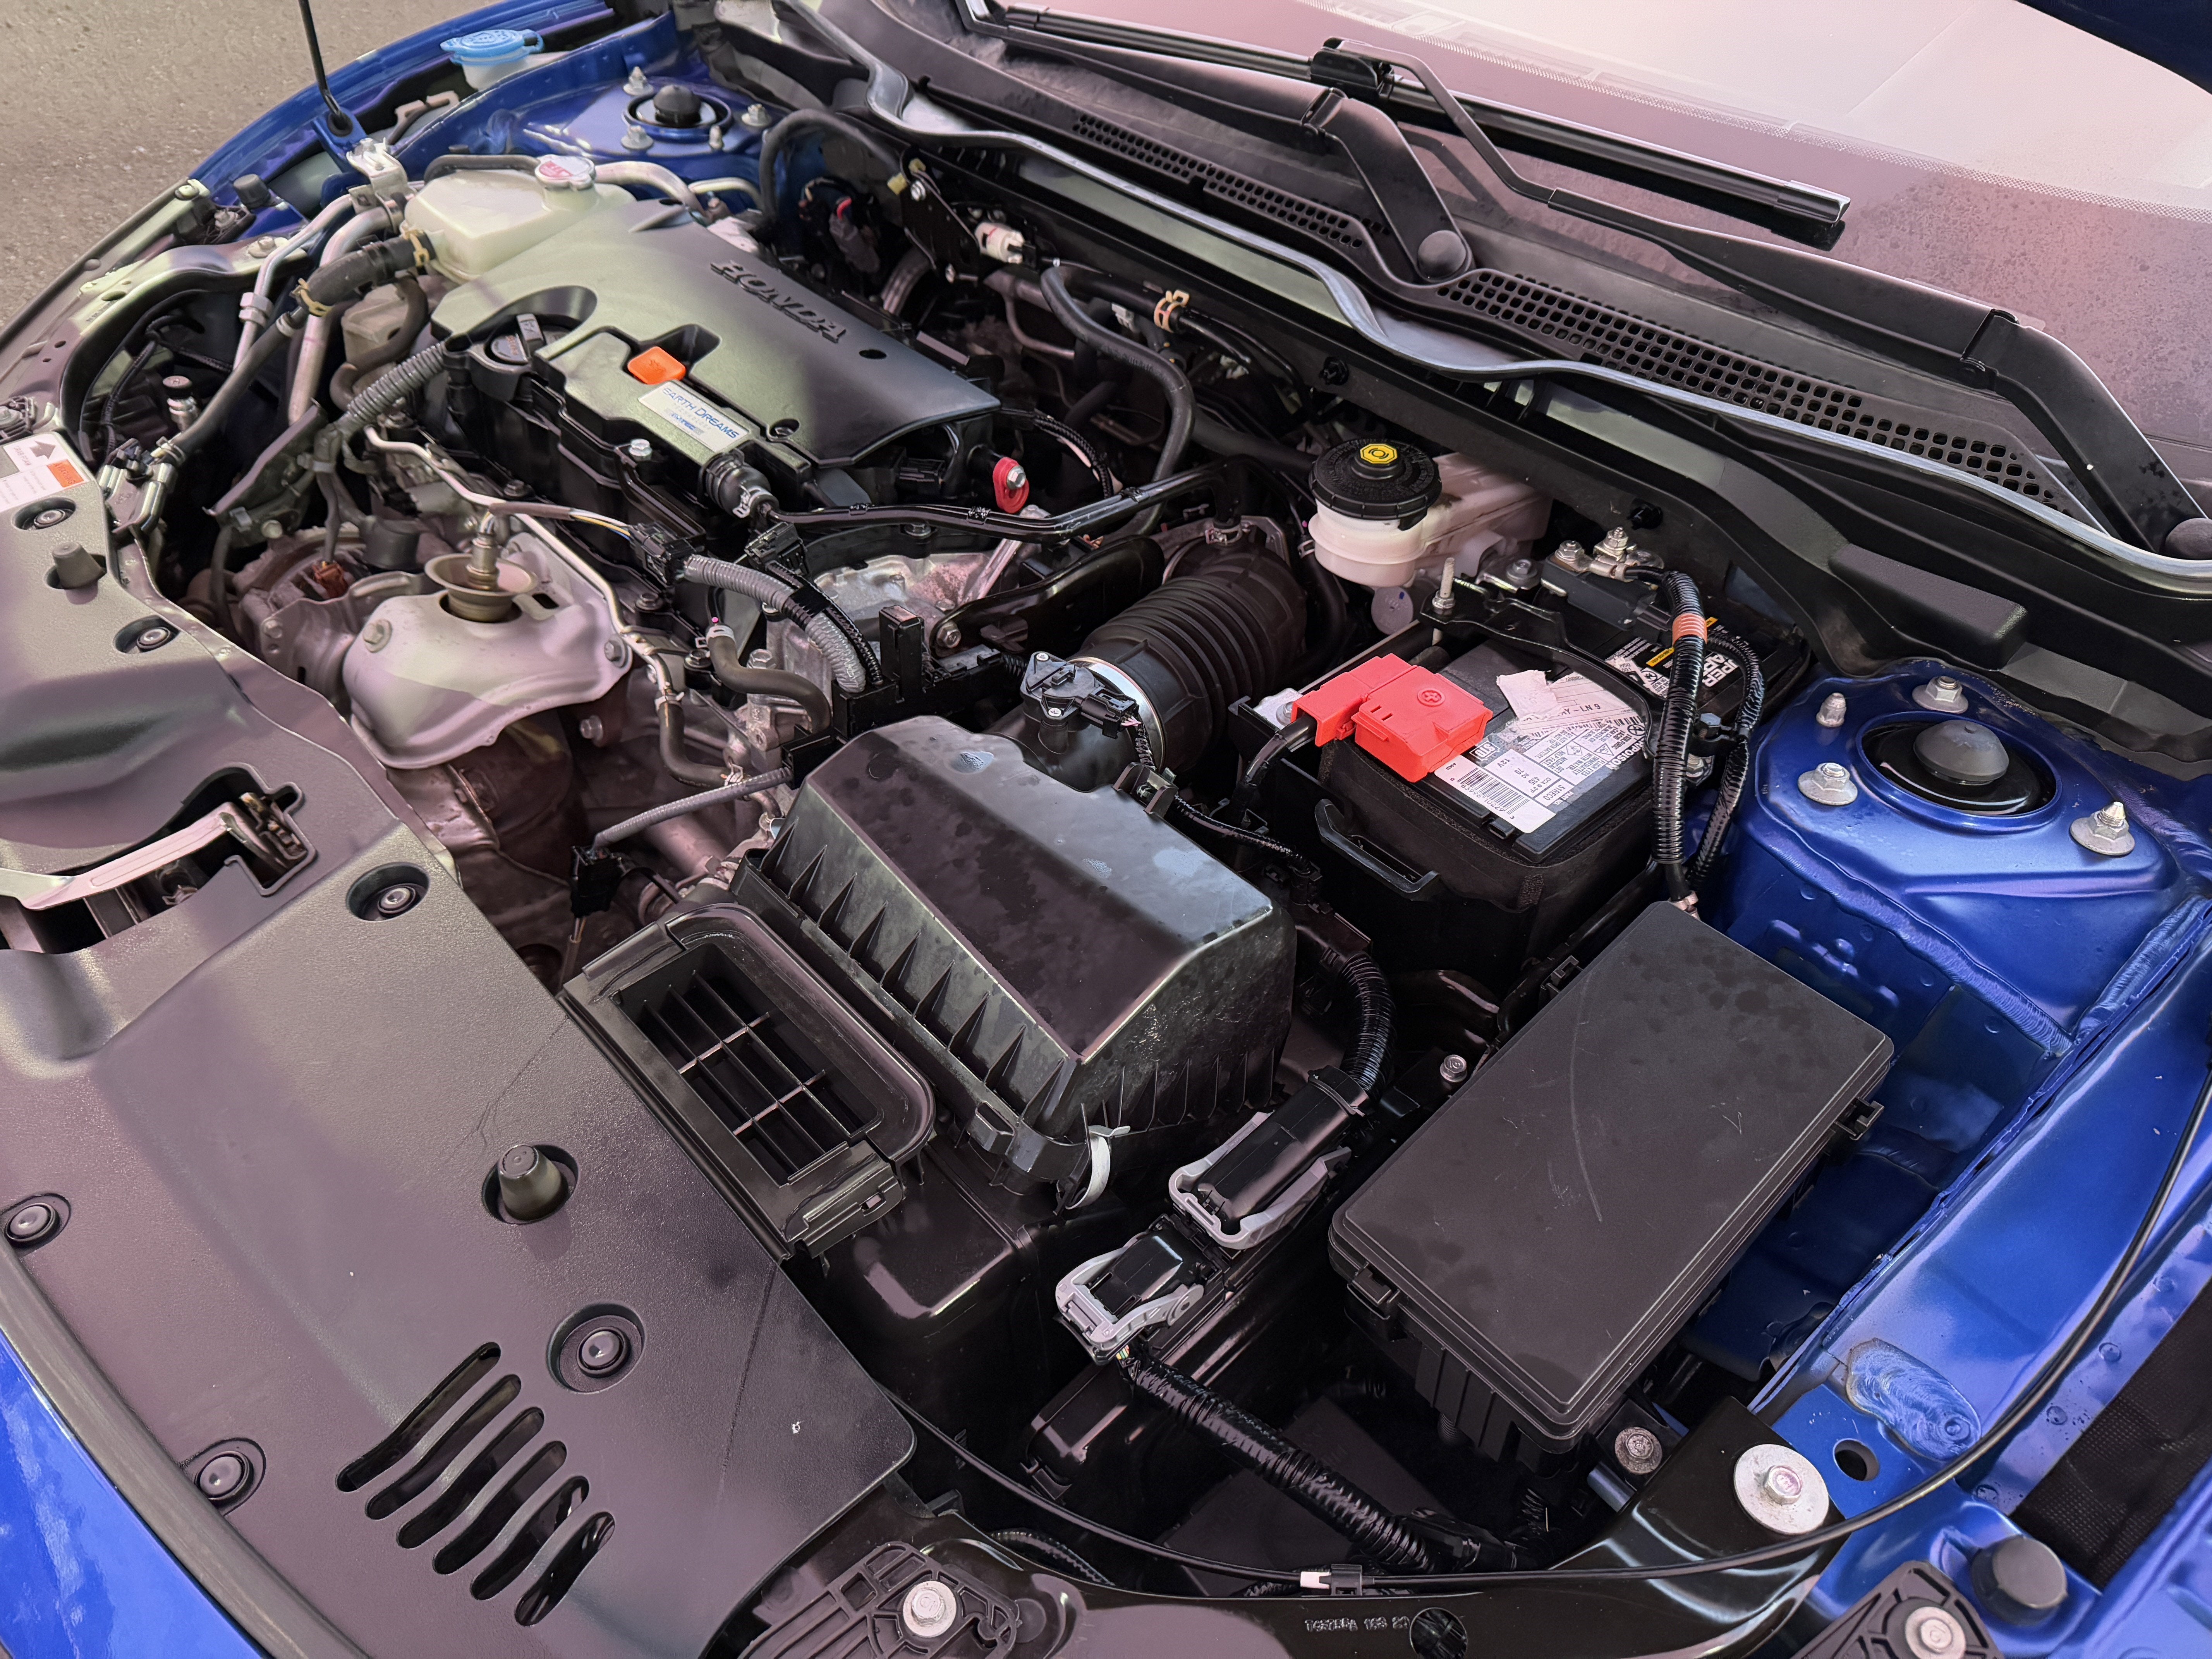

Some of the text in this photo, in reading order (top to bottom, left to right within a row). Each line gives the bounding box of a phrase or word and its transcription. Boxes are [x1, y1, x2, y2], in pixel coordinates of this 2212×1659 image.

[710, 260, 847, 343] HONDA
[662, 387, 696, 410] EARTH
[694, 407, 740, 438] DREAMS
[1610, 735, 1632, 750] SULFURIC
[1612, 732, 1625, 740] ACID
[1474, 740, 1496, 760] STD
[1552, 750, 1566, 759] HELP
[1580, 752, 1594, 761] WITH
[1496, 757, 1511, 768] 12V
[1547, 756, 1568, 770] MEDICAL
[1571, 756, 1600, 775] IMMEDIATELY
[1580, 759, 1606, 776] FLUSH EYES
[1527, 776, 1541, 785] 435
[1460, 783, 1482, 798] 83996
[1483, 798, 1505, 812] 10229
